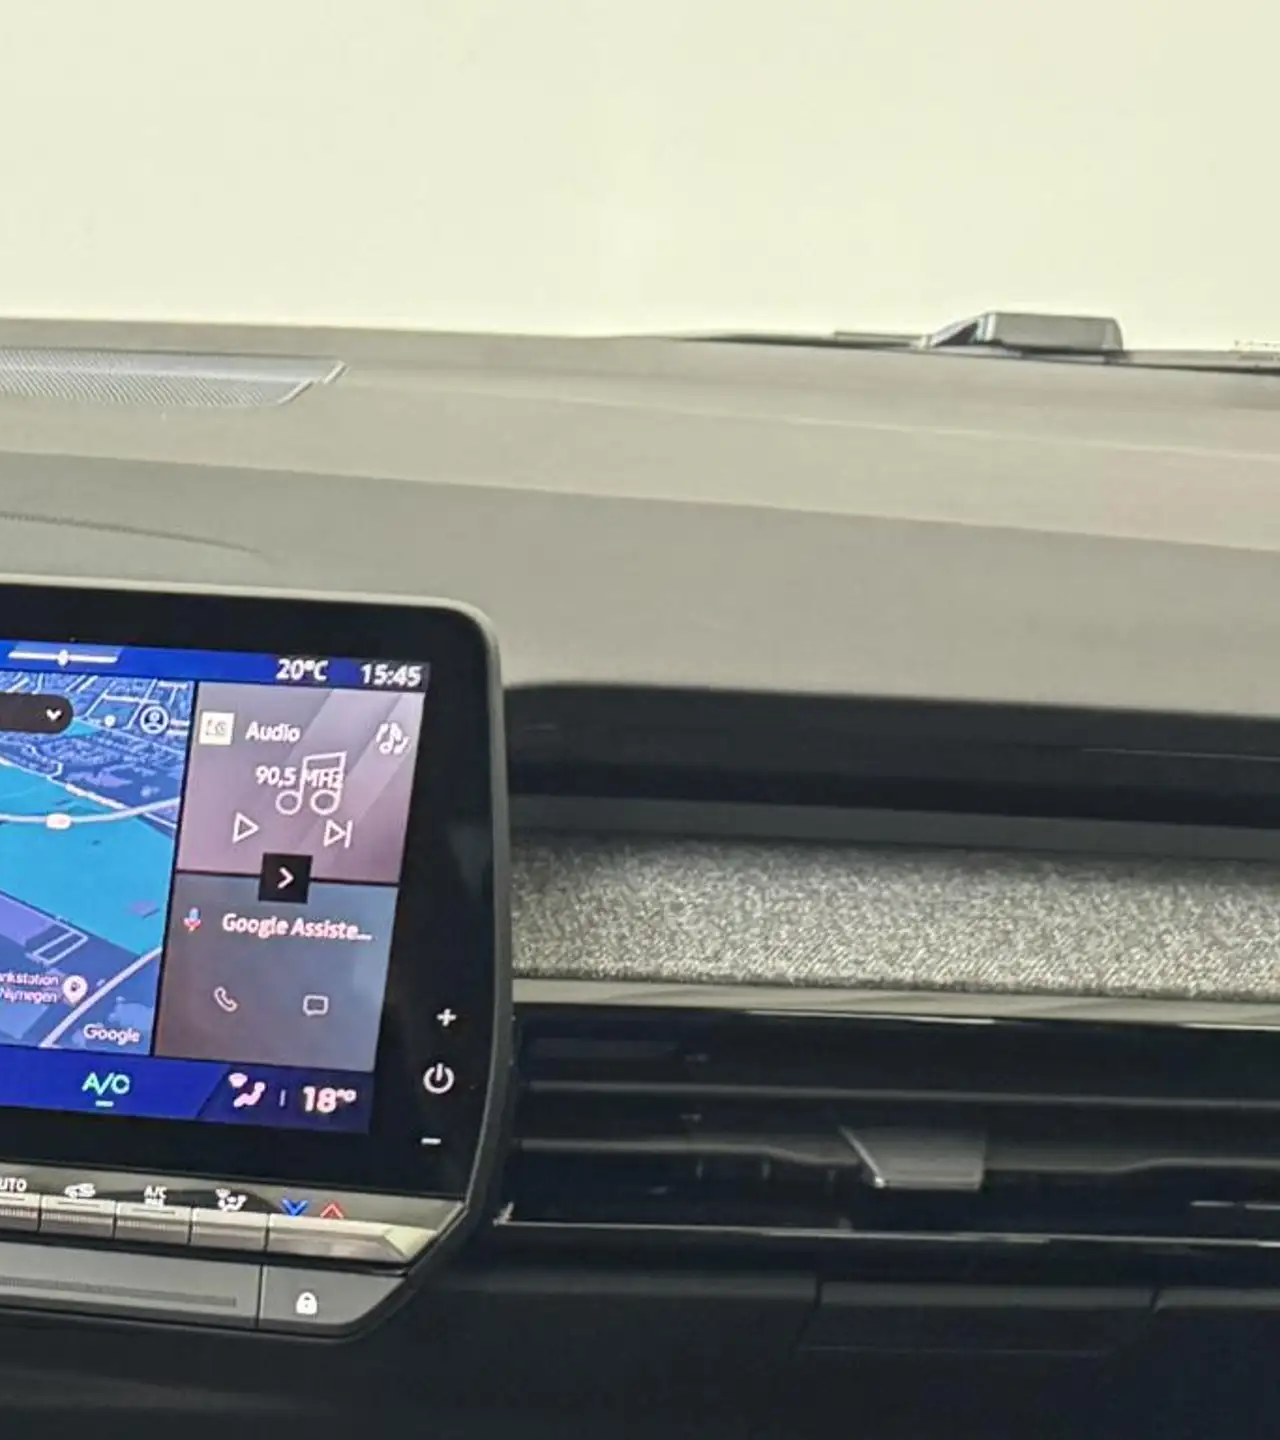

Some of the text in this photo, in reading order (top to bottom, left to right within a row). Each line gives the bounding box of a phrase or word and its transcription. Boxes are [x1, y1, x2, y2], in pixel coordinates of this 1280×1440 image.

[360, 662, 422, 688] 15:45
[244, 720, 302, 743] Audio
[221, 912, 289, 939] Google
[83, 1023, 141, 1046] Google
[81, 1071, 131, 1096] A/C
[143, 1184, 168, 1199] A/C
